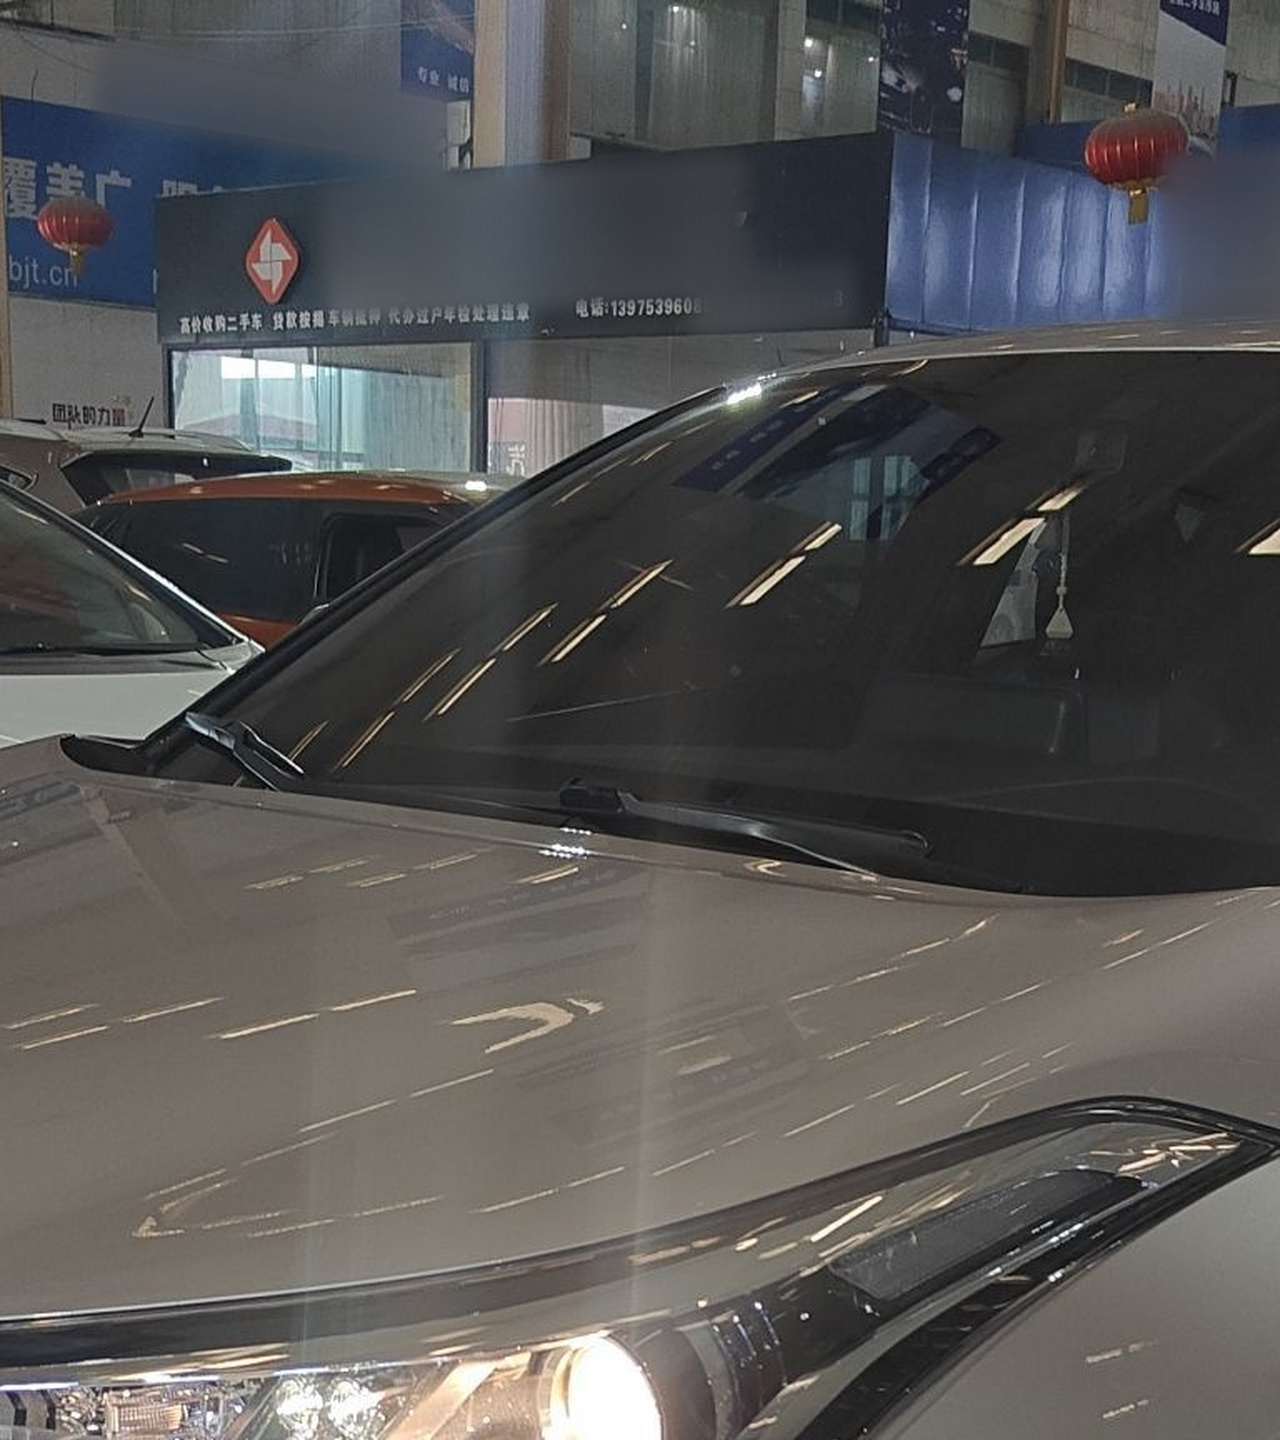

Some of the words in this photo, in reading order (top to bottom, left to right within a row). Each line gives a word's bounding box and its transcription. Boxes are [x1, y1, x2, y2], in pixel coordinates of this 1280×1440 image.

[180, 313, 263, 334] 高价收购二手车
